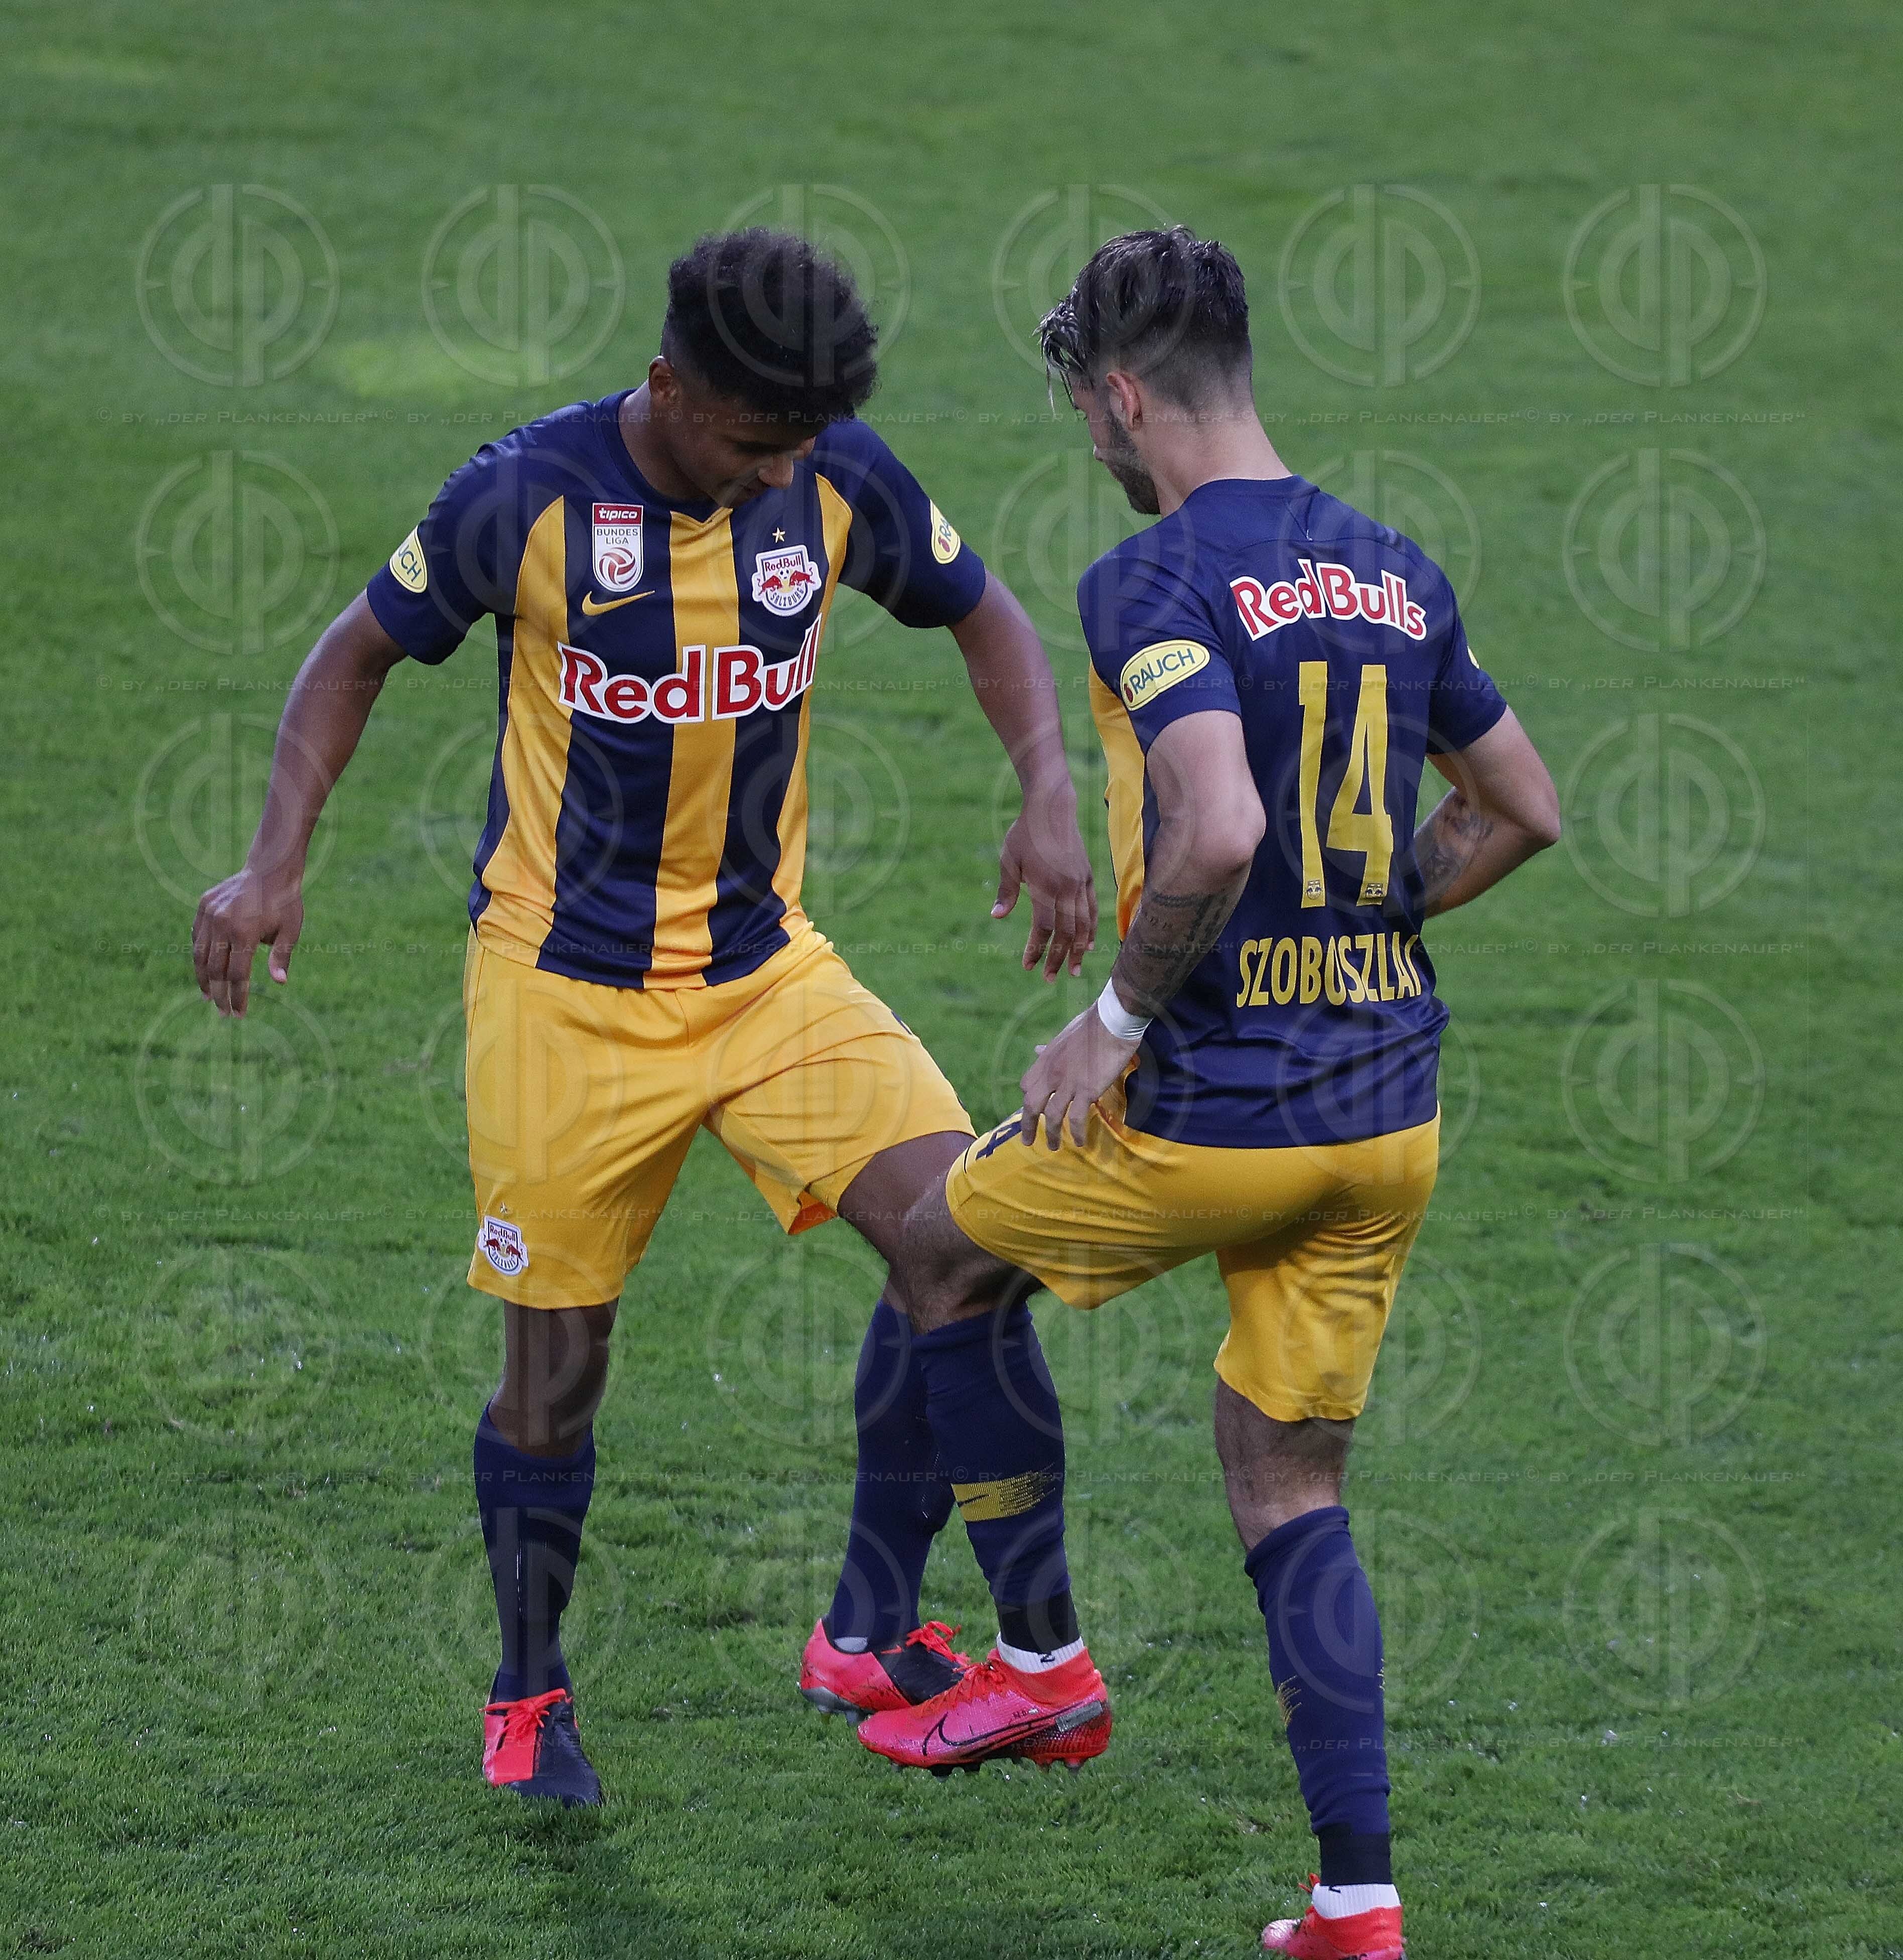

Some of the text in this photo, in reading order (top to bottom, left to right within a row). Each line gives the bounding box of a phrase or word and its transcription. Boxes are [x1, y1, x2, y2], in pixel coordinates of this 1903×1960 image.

[599, 507, 637, 520] tipico
[1129, 647, 1195, 695] RAUCH
[1299, 661, 1394, 908] 14
